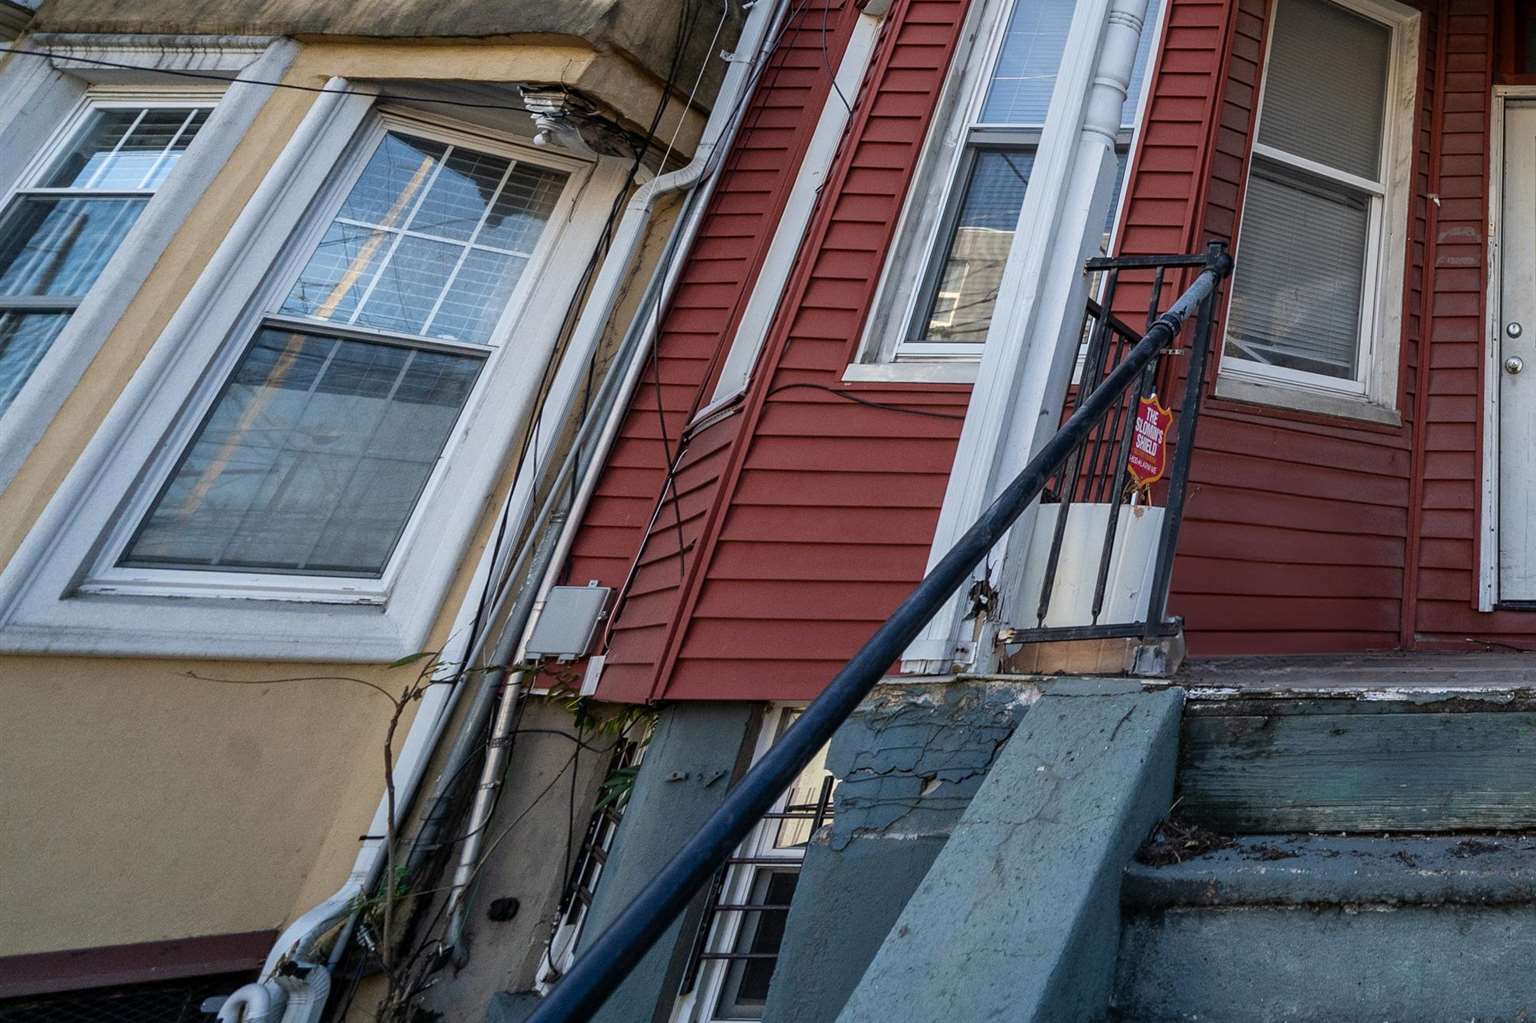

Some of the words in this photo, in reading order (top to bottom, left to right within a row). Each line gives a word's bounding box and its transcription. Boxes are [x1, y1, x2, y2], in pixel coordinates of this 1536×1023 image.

[1146, 407, 1159, 425] THE
[1135, 417, 1164, 444] SLOMIN'S
[1135, 434, 1158, 456] SHIELD
